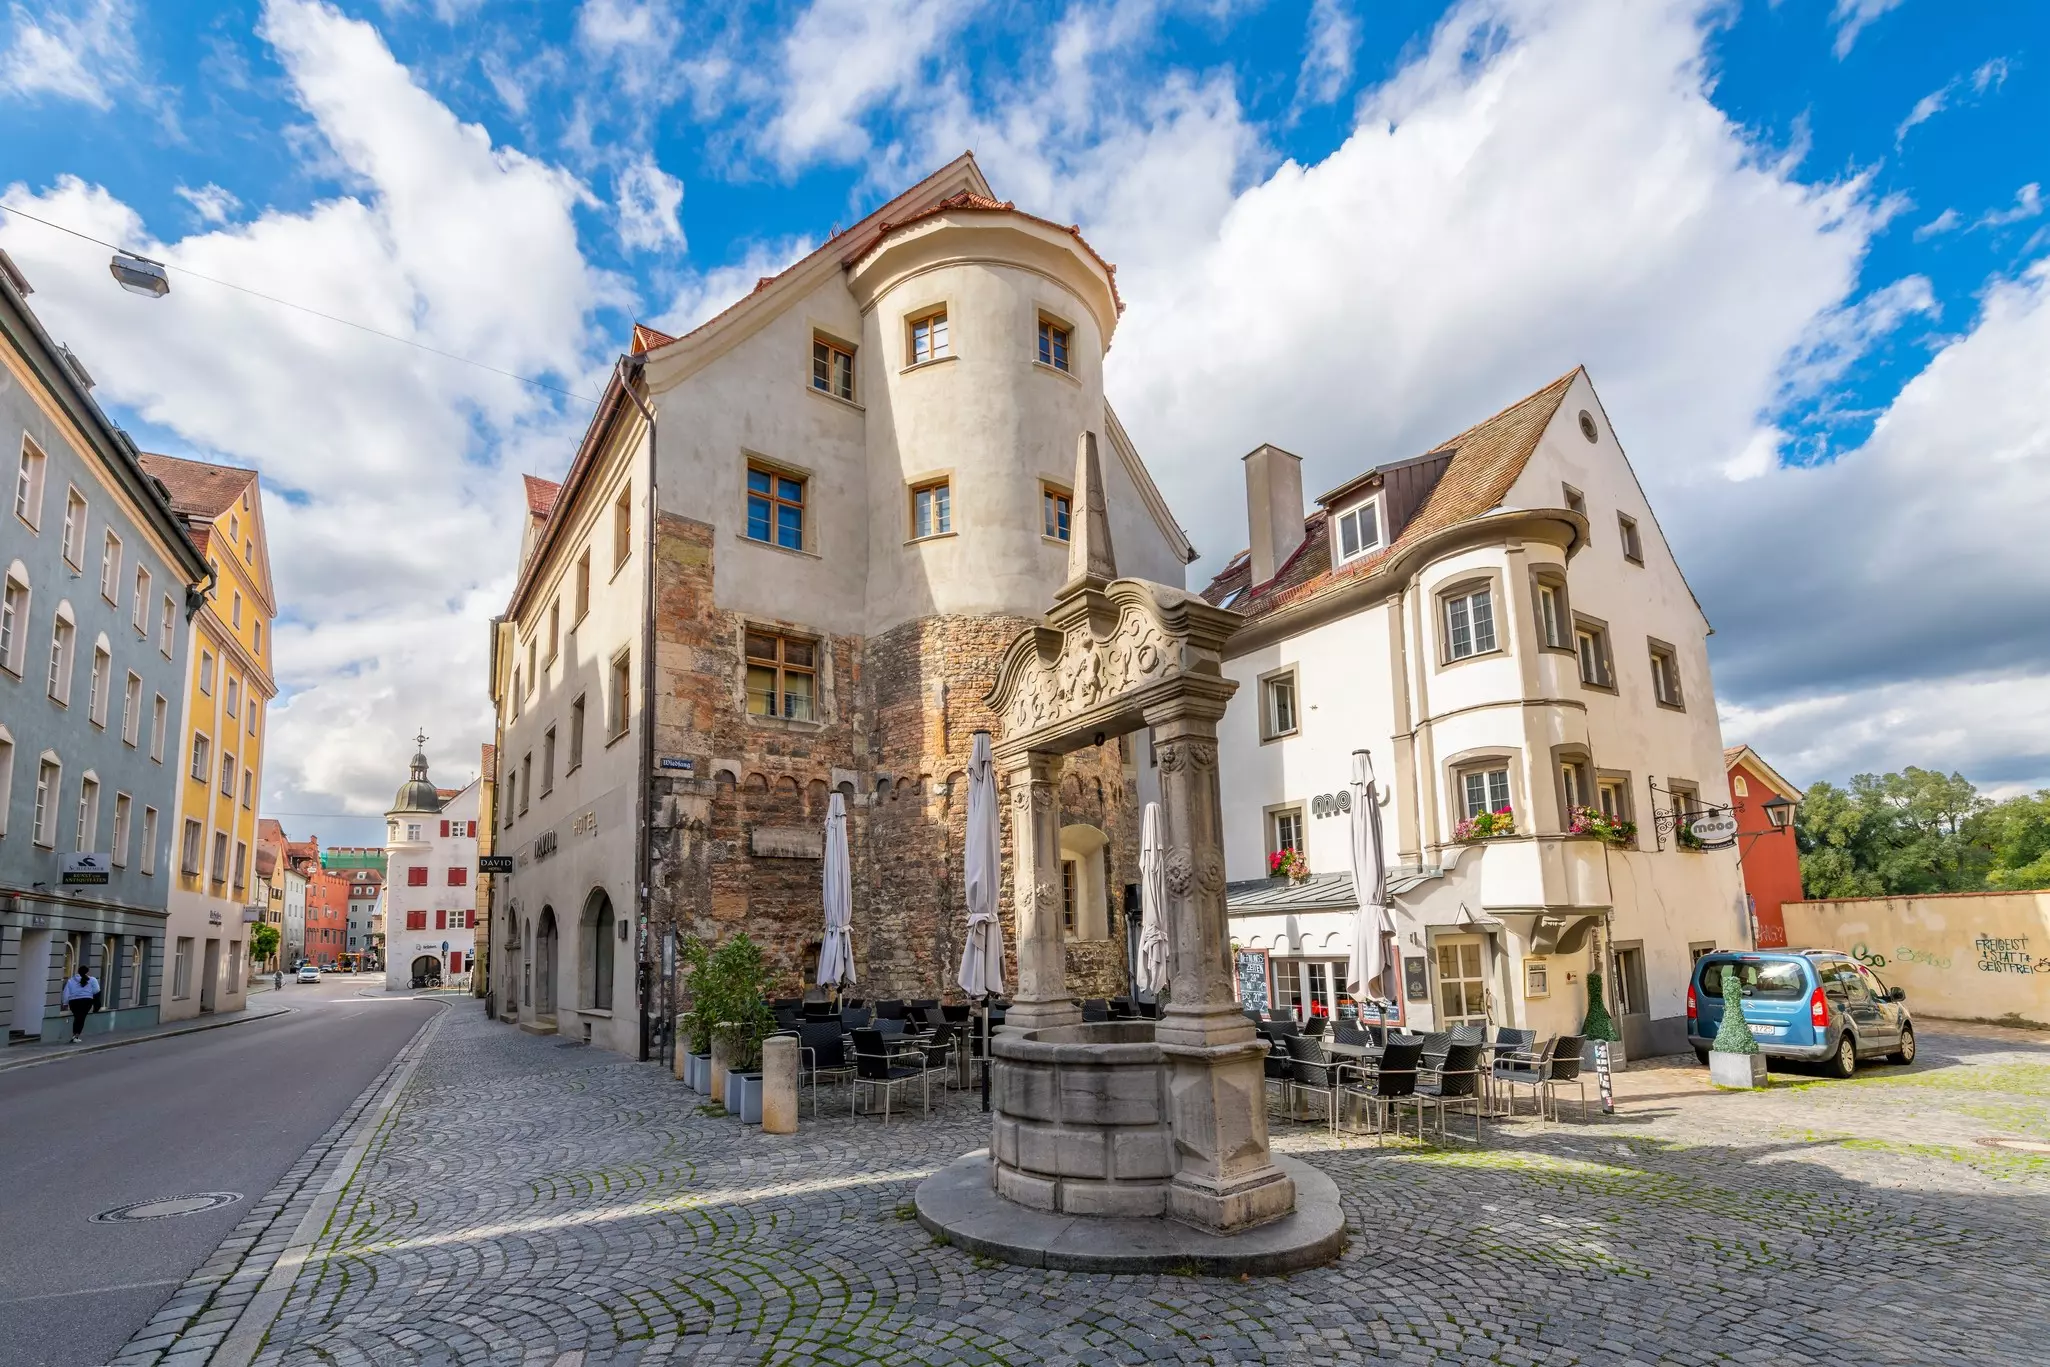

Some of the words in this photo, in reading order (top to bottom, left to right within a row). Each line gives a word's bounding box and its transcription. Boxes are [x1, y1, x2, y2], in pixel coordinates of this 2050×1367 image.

[573, 811, 598, 837] HOTEL
[1693, 820, 1734, 834] mood
[480, 859, 512, 867] DAVID
[1975, 936, 2028, 951] FREIGEIST
[1978, 960, 2034, 975] GEISTFREI
